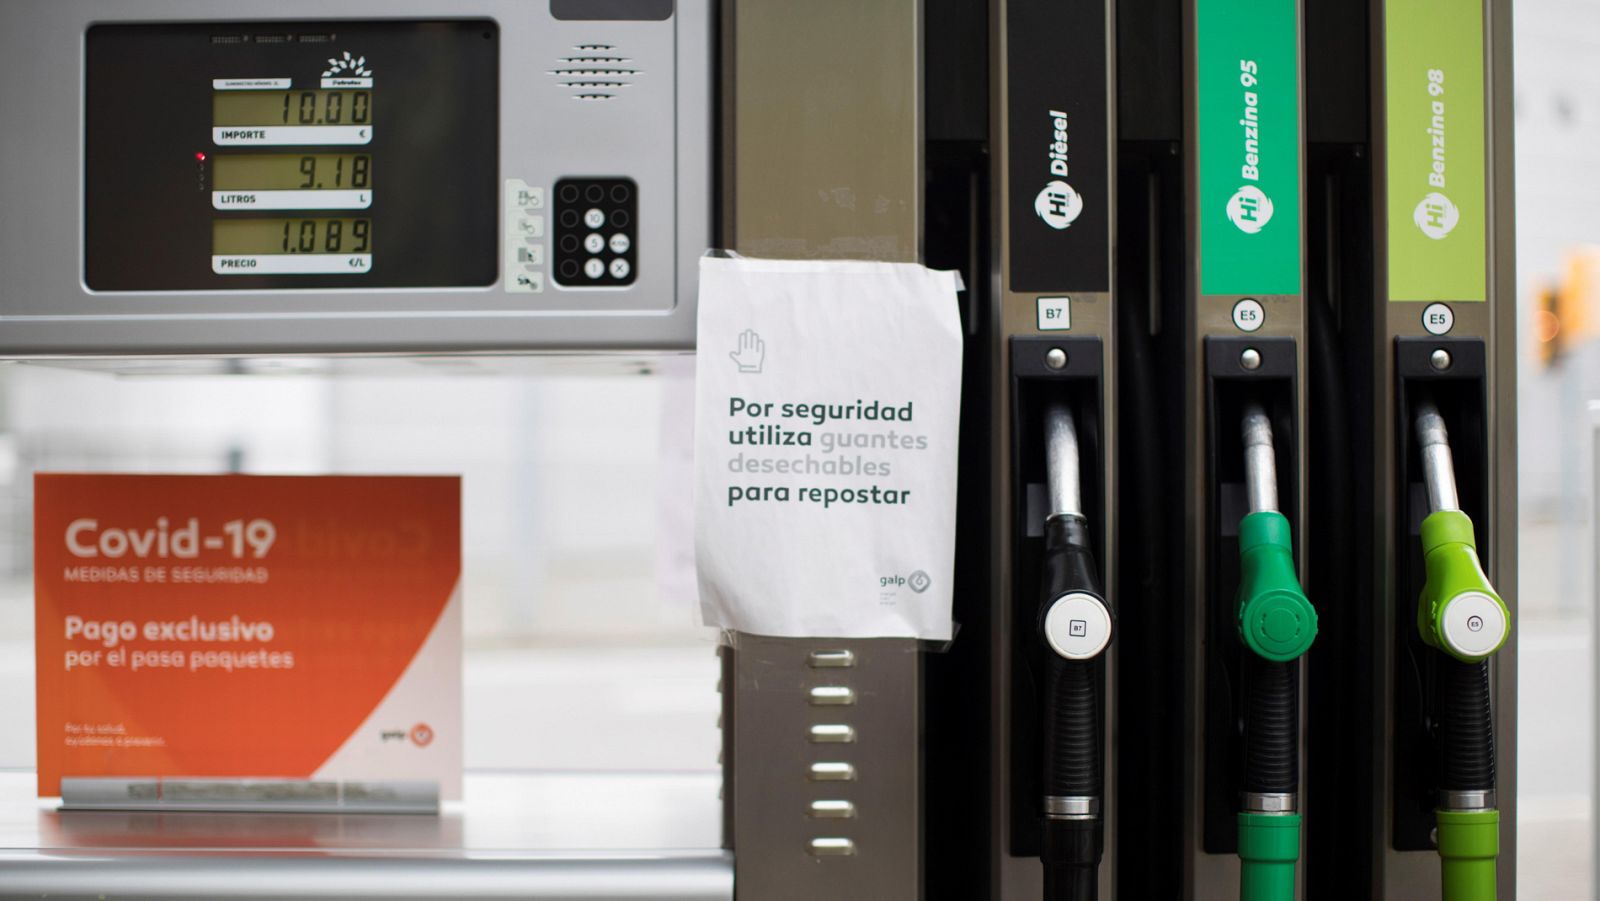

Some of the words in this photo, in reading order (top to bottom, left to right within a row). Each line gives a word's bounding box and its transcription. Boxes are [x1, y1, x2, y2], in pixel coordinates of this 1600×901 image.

[1239, 59, 1258, 88] 95
[1427, 68, 1445, 97] 98
[282, 92, 369, 124] 10.00
[221, 130, 266, 140] IMPORTE
[358, 130, 366, 139] €
[1048, 109, 1068, 177] Dièsel
[1239, 91, 1259, 181] Benzina
[1426, 100, 1445, 189] Benzina
[299, 156, 368, 189] 9.18
[220, 194, 256, 204] LITROS
[359, 194, 366, 203] L
[1047, 191, 1066, 217] Hi
[1239, 196, 1258, 222] Hi
[1425, 203, 1444, 229] Hi
[282, 220, 369, 253] 1.089
[220, 259, 257, 268] PRECIO
[348, 258, 366, 268] €/L
[1045, 307, 1063, 320] B7
[1240, 308, 1257, 321] E5
[1429, 312, 1446, 325] E5
[729, 397, 774, 418] Por
[780, 399, 913, 425] seguridad
[728, 424, 813, 447] utiliza
[819, 429, 929, 454] guantes
[727, 452, 892, 477] desechables
[727, 484, 790, 507] para
[798, 485, 911, 508] repostar
[64, 517, 277, 559] Covid-19
[64, 566, 139, 583] MEDIDAS
[144, 566, 167, 583] DE
[172, 567, 269, 584] SEGURIDAD
[879, 573, 906, 588] galp
[64, 616, 136, 647] Pago
[144, 615, 275, 642] exclusivo
[64, 650, 103, 671] por
[107, 646, 126, 668] el
[131, 650, 186, 672] pasa
[190, 649, 295, 673] paquetes
